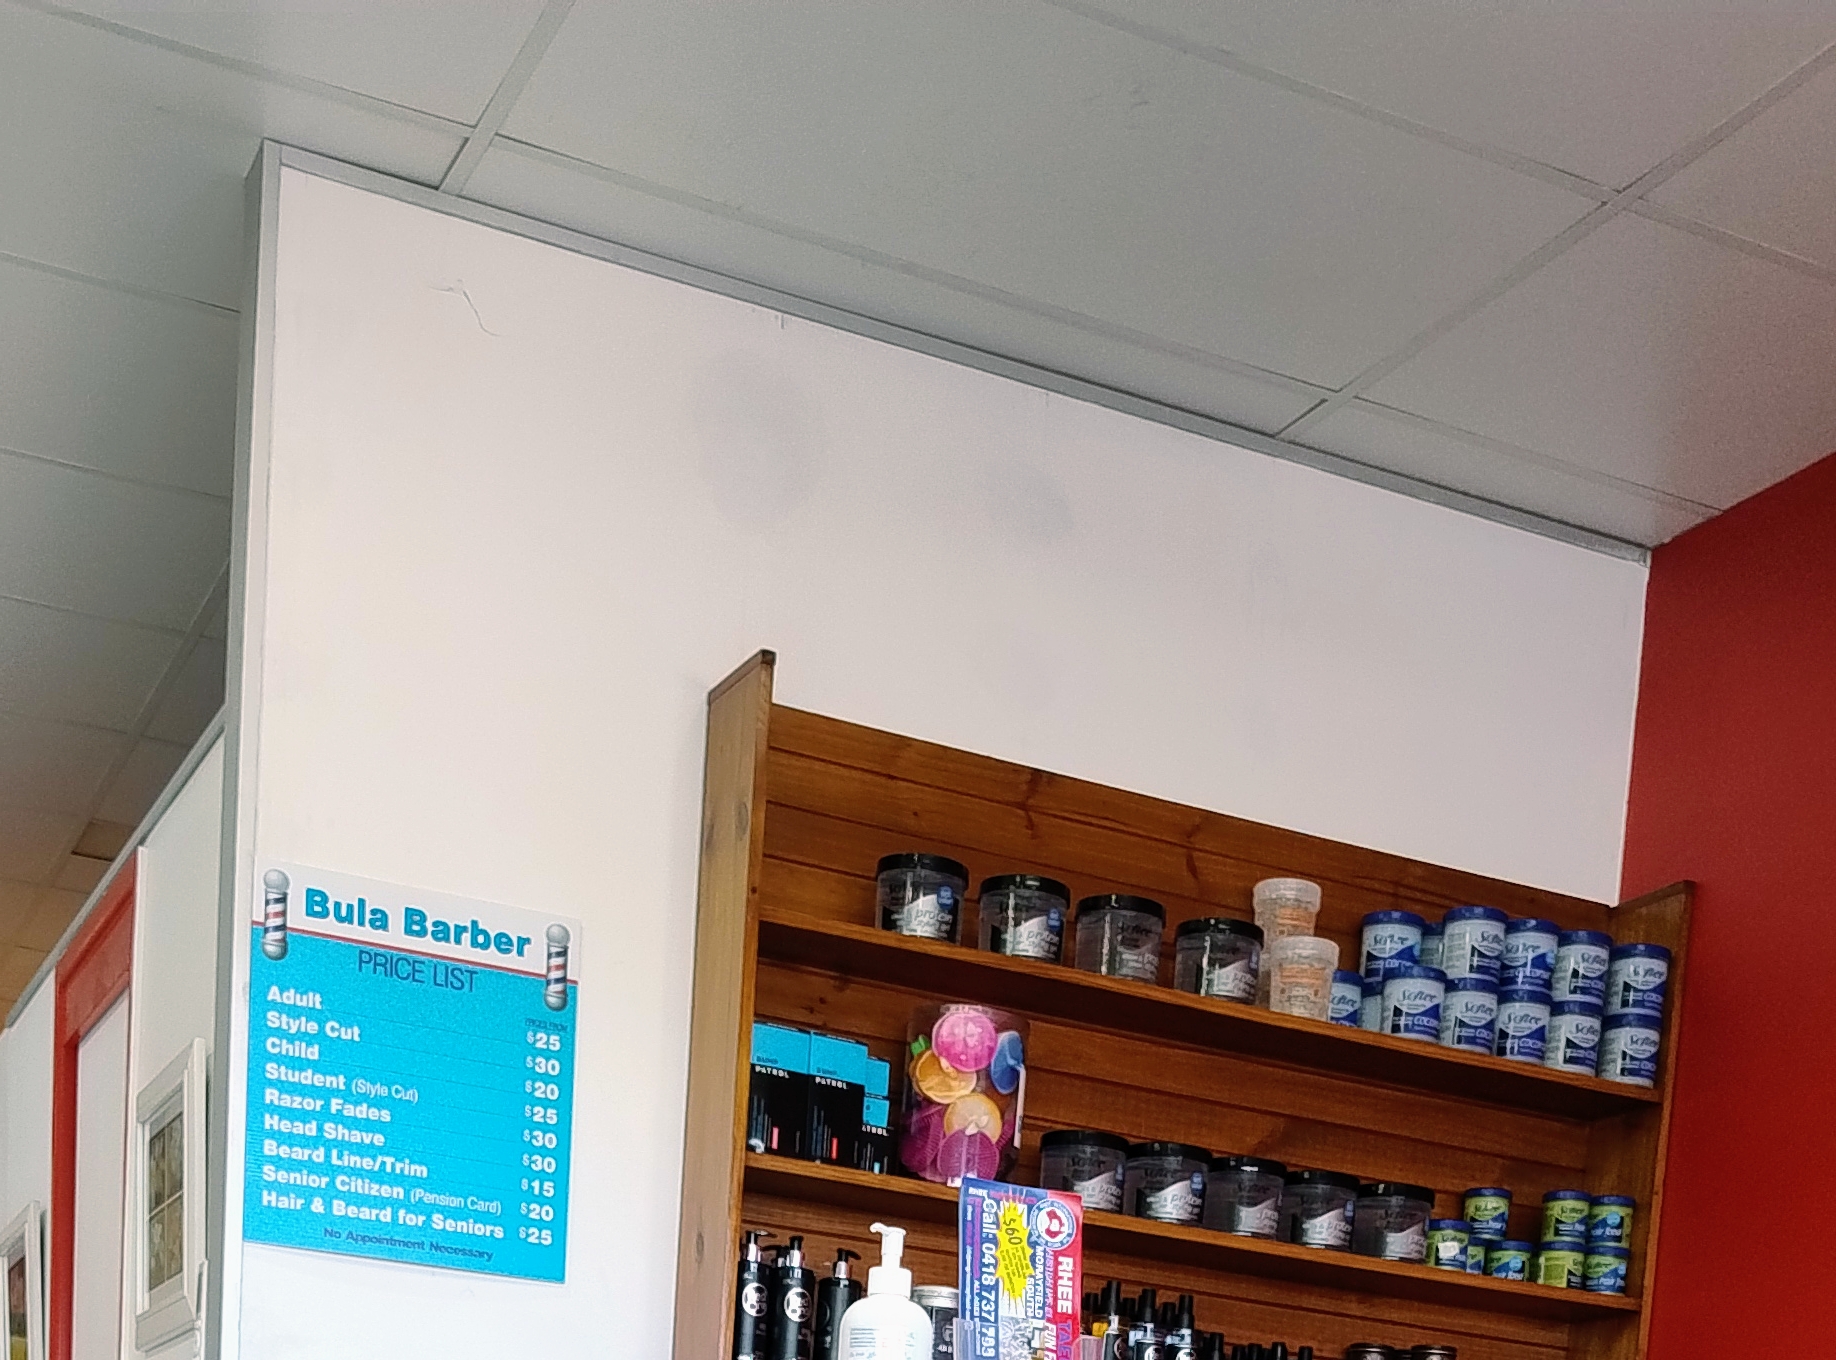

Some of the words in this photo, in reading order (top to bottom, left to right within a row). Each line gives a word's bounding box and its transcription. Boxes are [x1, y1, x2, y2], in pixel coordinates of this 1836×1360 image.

[304, 887, 390, 933] Bula
[403, 906, 532, 958] Barber
[358, 949, 425, 984] PRICE
[433, 966, 479, 993] LIST
[266, 1010, 319, 1034] Style
[325, 1020, 360, 1042] Cut
[525, 1055, 560, 1076] $30
[267, 985, 322, 1009] Adult
[526, 1030, 561, 1051] $25
[265, 1062, 346, 1090] Student
[351, 1077, 388, 1098] (Style
[391, 1084, 419, 1105] Cut)
[524, 1104, 558, 1125] $25
[266, 1037, 319, 1060] Child
[525, 1080, 559, 1101] $20
[755, 1065, 790, 1079] PATROL
[815, 1076, 849, 1090] PATROL
[264, 1088, 325, 1112] Razor
[330, 1098, 391, 1122] Fades
[523, 1129, 557, 1149] $30
[264, 1113, 317, 1136] Head
[323, 1122, 386, 1146] Shave
[522, 1153, 557, 1173] $30
[862, 1124, 890, 1137] ATROL
[263, 1139, 325, 1163] Beard
[331, 1149, 428, 1178] Line/Trim
[521, 1178, 555, 1197] $15
[262, 1165, 329, 1188] Senior
[335, 1175, 404, 1199] Citizen
[411, 1187, 465, 1208] (Pension
[467, 1196, 502, 1216] Card)
[520, 1202, 554, 1222] $20
[262, 1189, 305, 1211] Hair
[310, 1197, 325, 1214] &
[332, 1199, 392, 1222] Beard
[398, 1209, 427, 1227] for
[431, 1213, 504, 1239] Seniors
[518, 1226, 553, 1246] $25
[982, 1197, 998, 1239] Call:
[323, 1228, 342, 1240] No
[346, 1230, 426, 1250] Appointment
[429, 1241, 494, 1262] Necessary
[1002, 1217, 1024, 1246] $60
[981, 1242, 997, 1286] 0418
[1035, 1245, 1045, 1318] MORAYFIELD
[1056, 1256, 1074, 1315] RHEE
[981, 1290, 996, 1323] 737
[1025, 1277, 1035, 1316] SOUTH
[981, 1326, 996, 1357] 799
[1044, 1321, 1057, 1348] FUN
